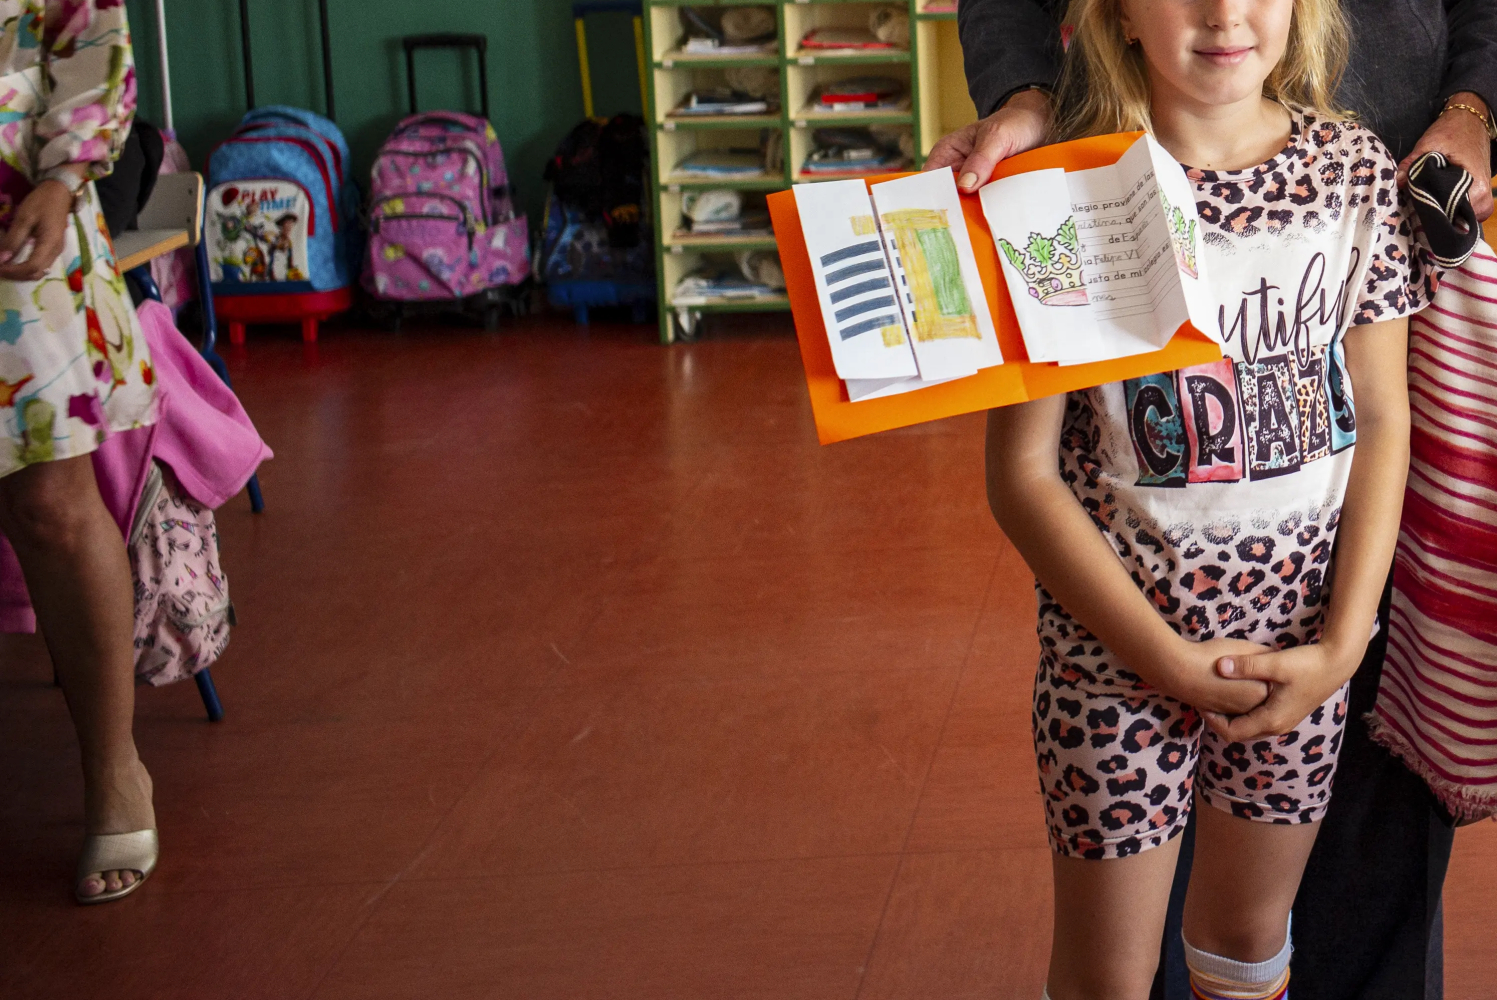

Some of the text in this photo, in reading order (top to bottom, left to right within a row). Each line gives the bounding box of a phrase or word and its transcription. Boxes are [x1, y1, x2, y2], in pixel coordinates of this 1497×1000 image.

[241, 187, 279, 203] PLAY
[1102, 189, 1136, 211] proviene
[1143, 170, 1155, 181] las
[1125, 210, 1137, 224] que
[1138, 199, 1148, 212] son
[1147, 188, 1157, 201] las
[1108, 234, 1121, 244] de
[1093, 253, 1122, 267] Felipe
[1113, 270, 1126, 280] de
[1130, 269, 1143, 279] mi
